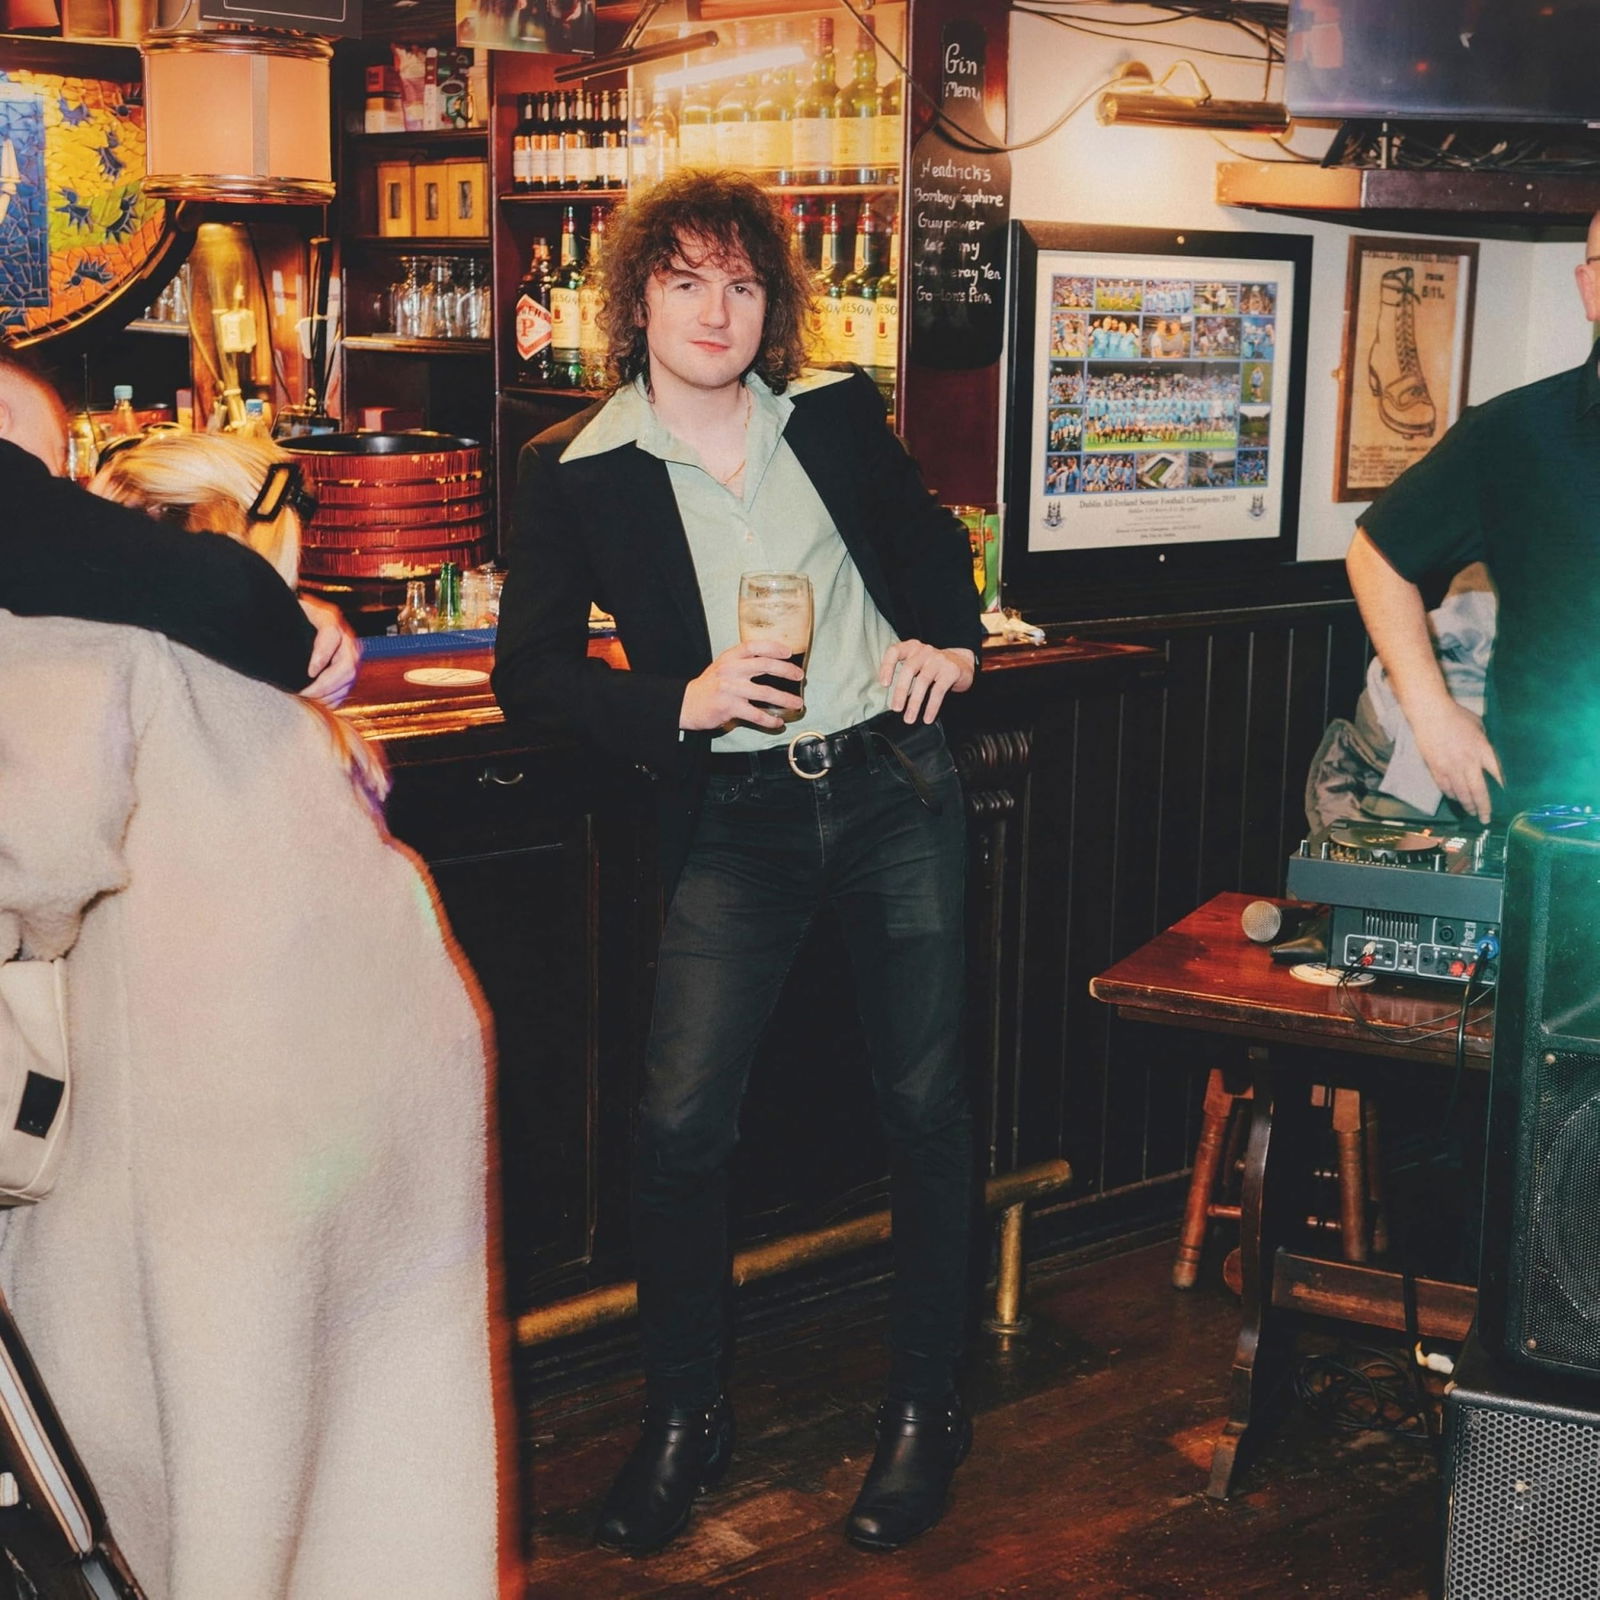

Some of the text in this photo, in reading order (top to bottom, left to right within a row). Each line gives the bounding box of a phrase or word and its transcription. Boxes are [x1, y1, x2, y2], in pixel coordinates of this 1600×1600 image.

[945, 43, 977, 75] Gin
[914, 187, 957, 210] Bombay
[981, 262, 1002, 280] Ten
[520, 318, 535, 337] P
